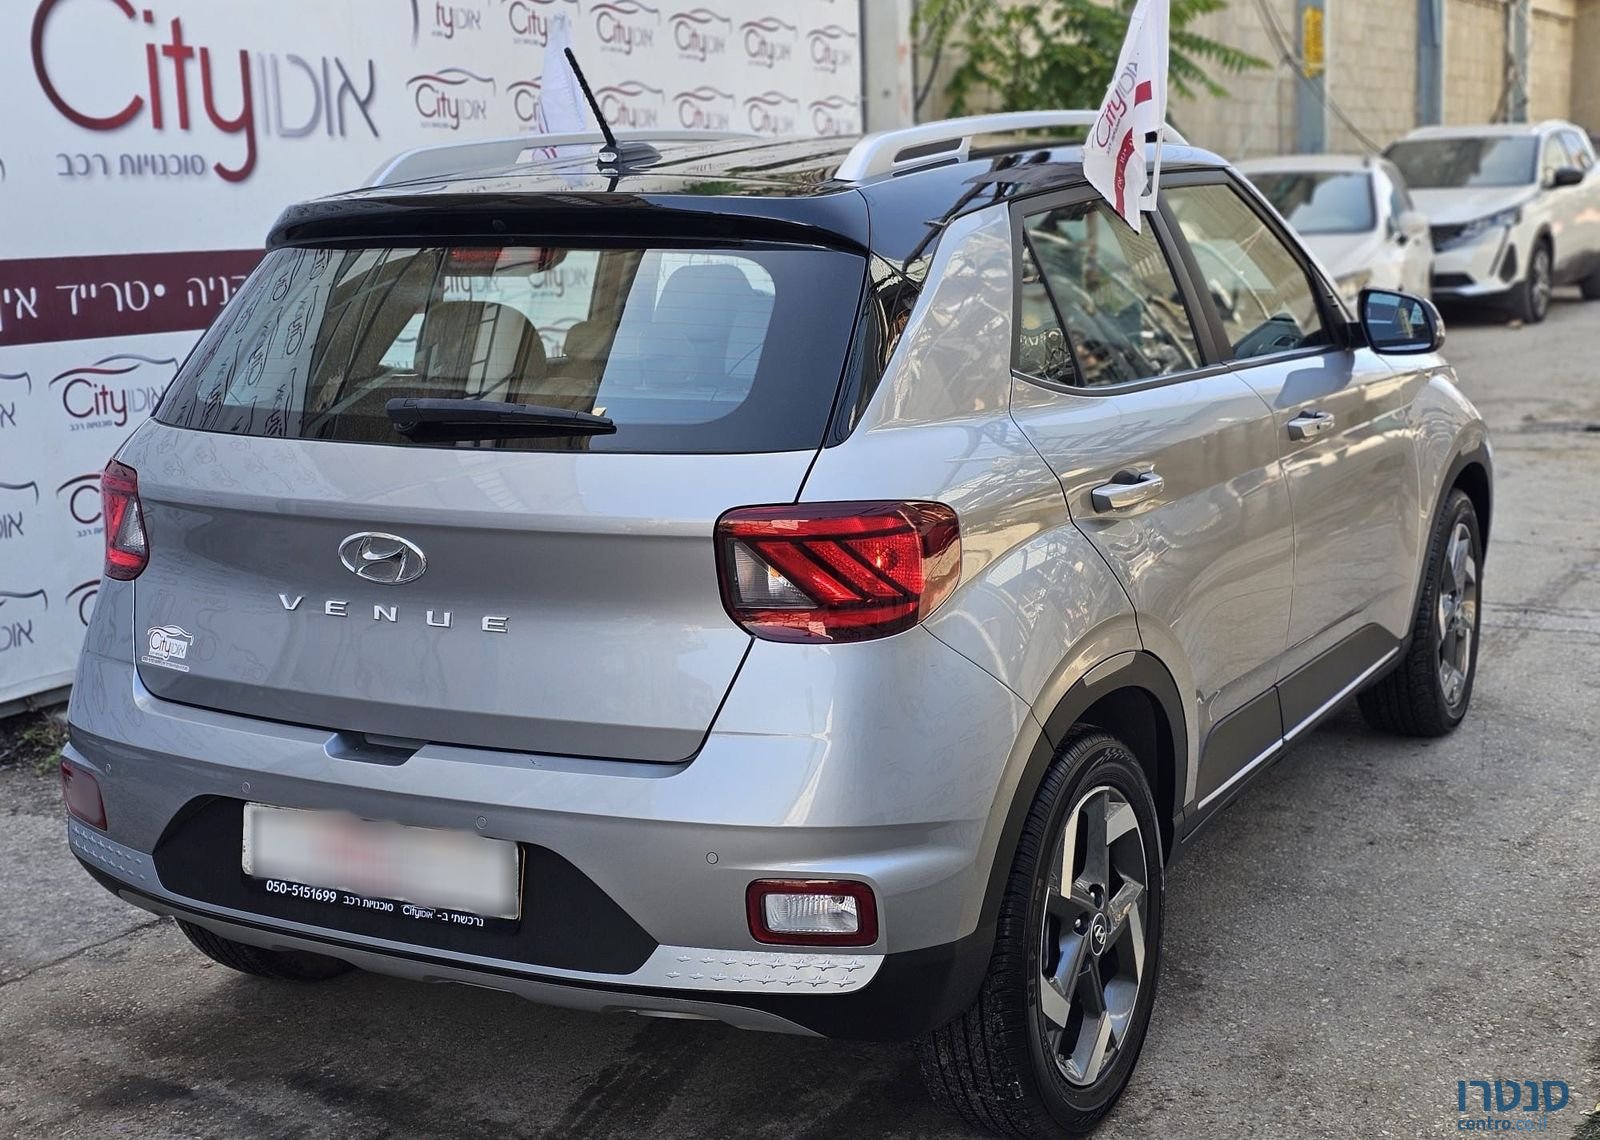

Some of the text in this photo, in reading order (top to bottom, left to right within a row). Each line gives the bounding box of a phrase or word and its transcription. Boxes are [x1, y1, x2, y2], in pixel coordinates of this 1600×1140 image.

[509, 1, 548, 48] City
[31, 0, 256, 182] City
[415, 83, 460, 131] City
[56, 153, 207, 177] סוכנויות רכב
[56, 281, 149, 315] טרייד
[63, 378, 127, 427] City
[278, 593, 510, 633] VENUE
[266, 879, 337, 904] 050-5151699
[343, 895, 361, 906] רכב
[362, 899, 394, 912] סוכנויות
[451, 913, 484, 927] נרכשתי
